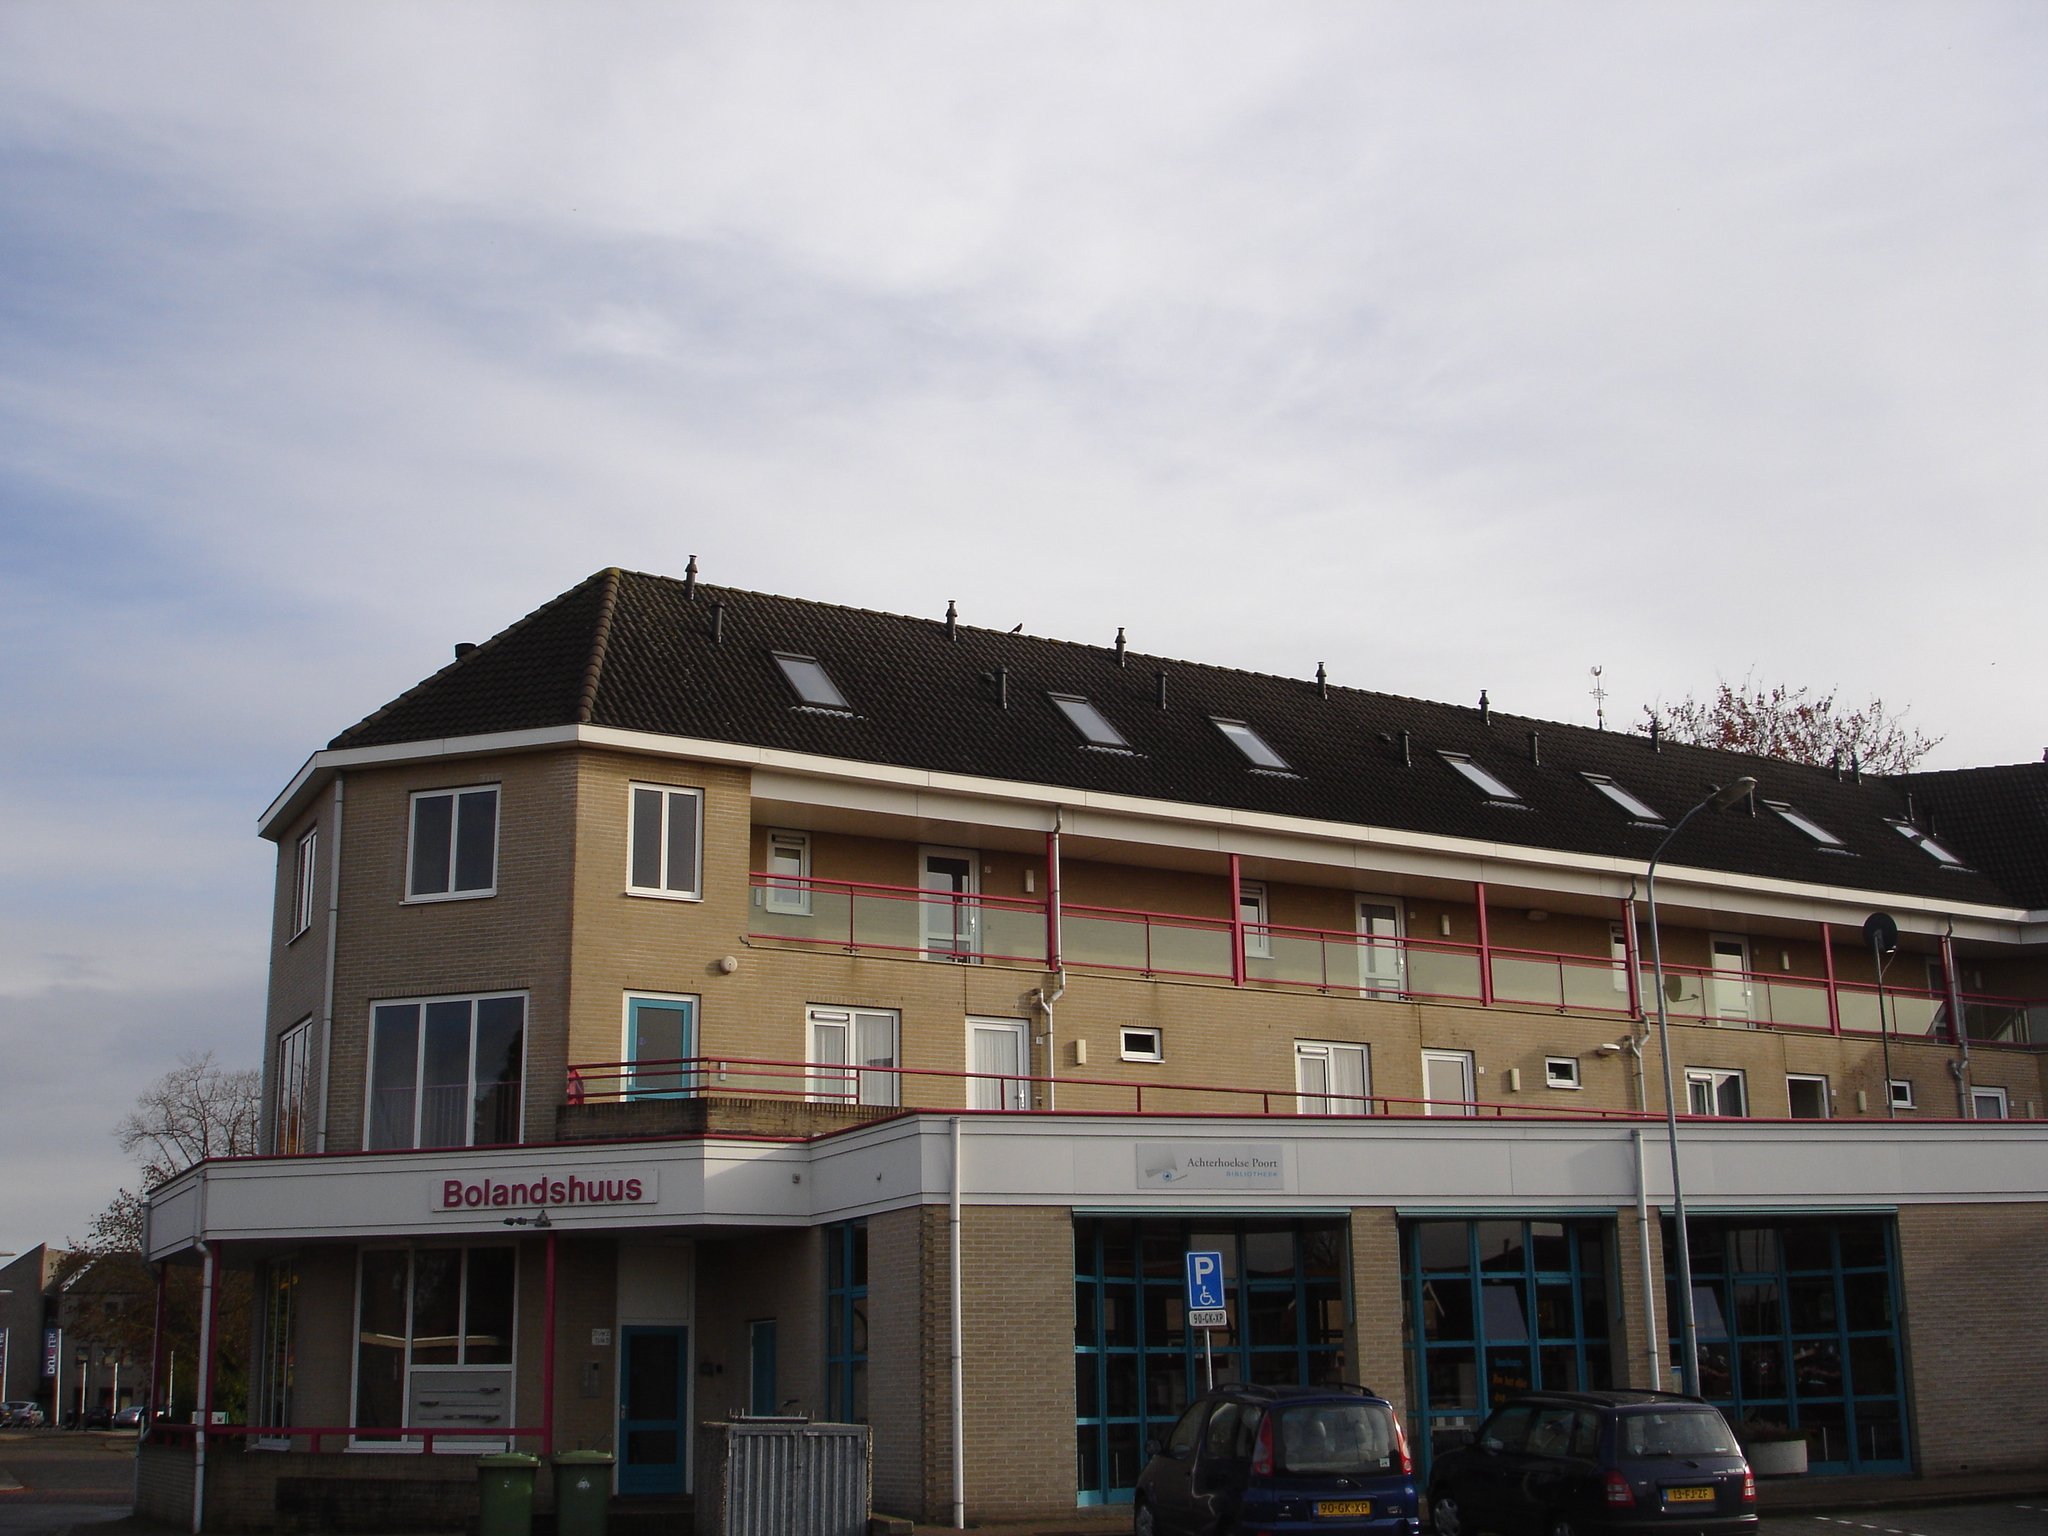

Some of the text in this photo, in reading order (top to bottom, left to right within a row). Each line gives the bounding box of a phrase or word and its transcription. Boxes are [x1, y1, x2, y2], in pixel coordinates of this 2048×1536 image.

[1187, 1158, 1277, 1168] Achterhoekse Poort
[443, 1175, 642, 1208] Bolandshuus
[1194, 1256, 1214, 1285] P
